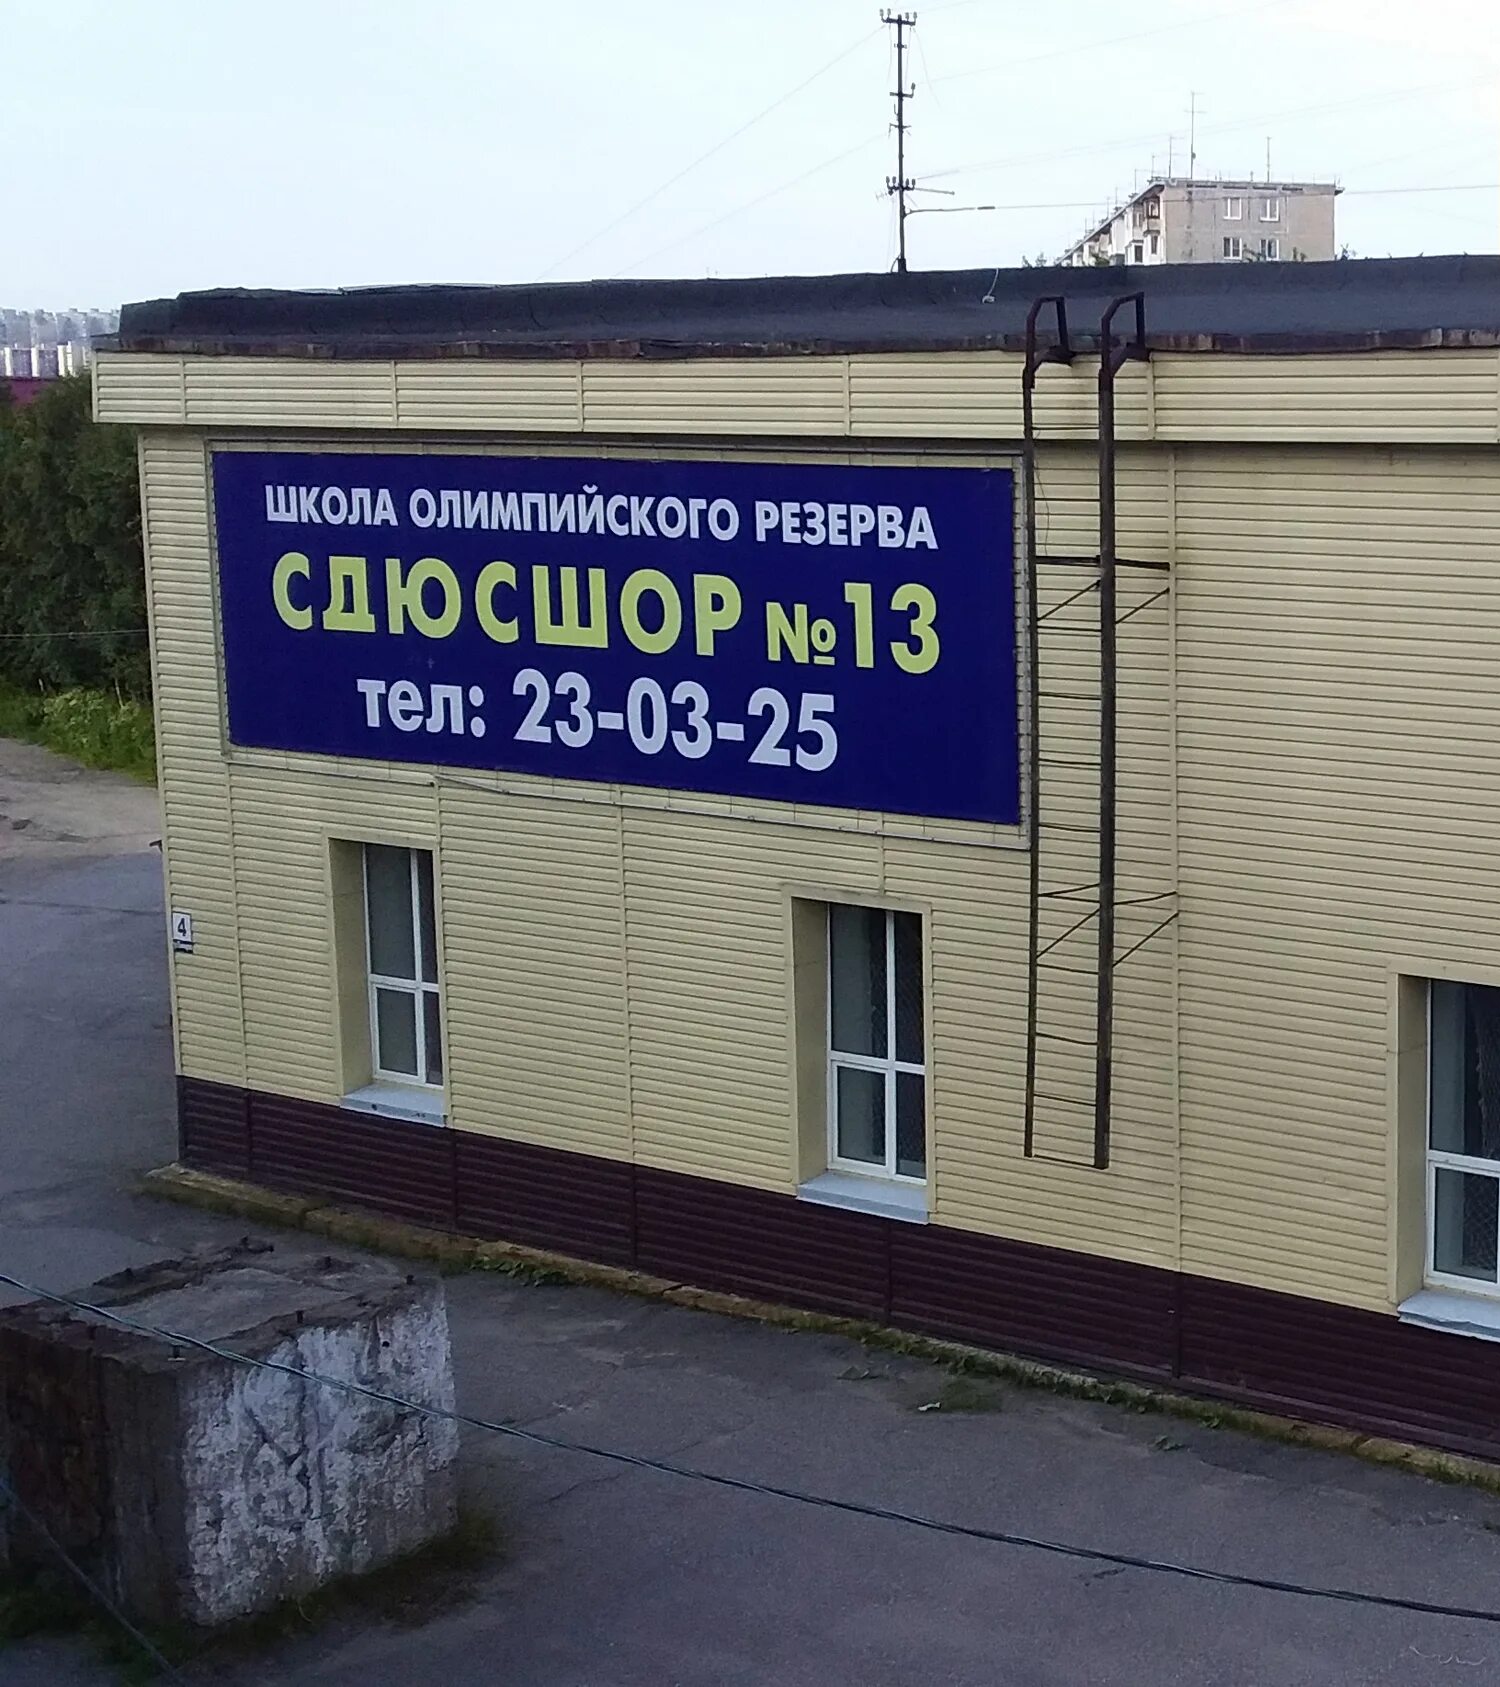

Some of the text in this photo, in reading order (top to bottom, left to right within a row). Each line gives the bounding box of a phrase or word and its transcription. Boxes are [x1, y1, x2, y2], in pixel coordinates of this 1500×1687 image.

[265, 483, 940, 550] ШКОЛА ОЛИМПИЙСКОГО РЕЗЕРВА
[272, 551, 742, 657] СДЮСШОР
[356, 668, 838, 772] тел: 23-03-25
[178, 918, 187, 936] 4
